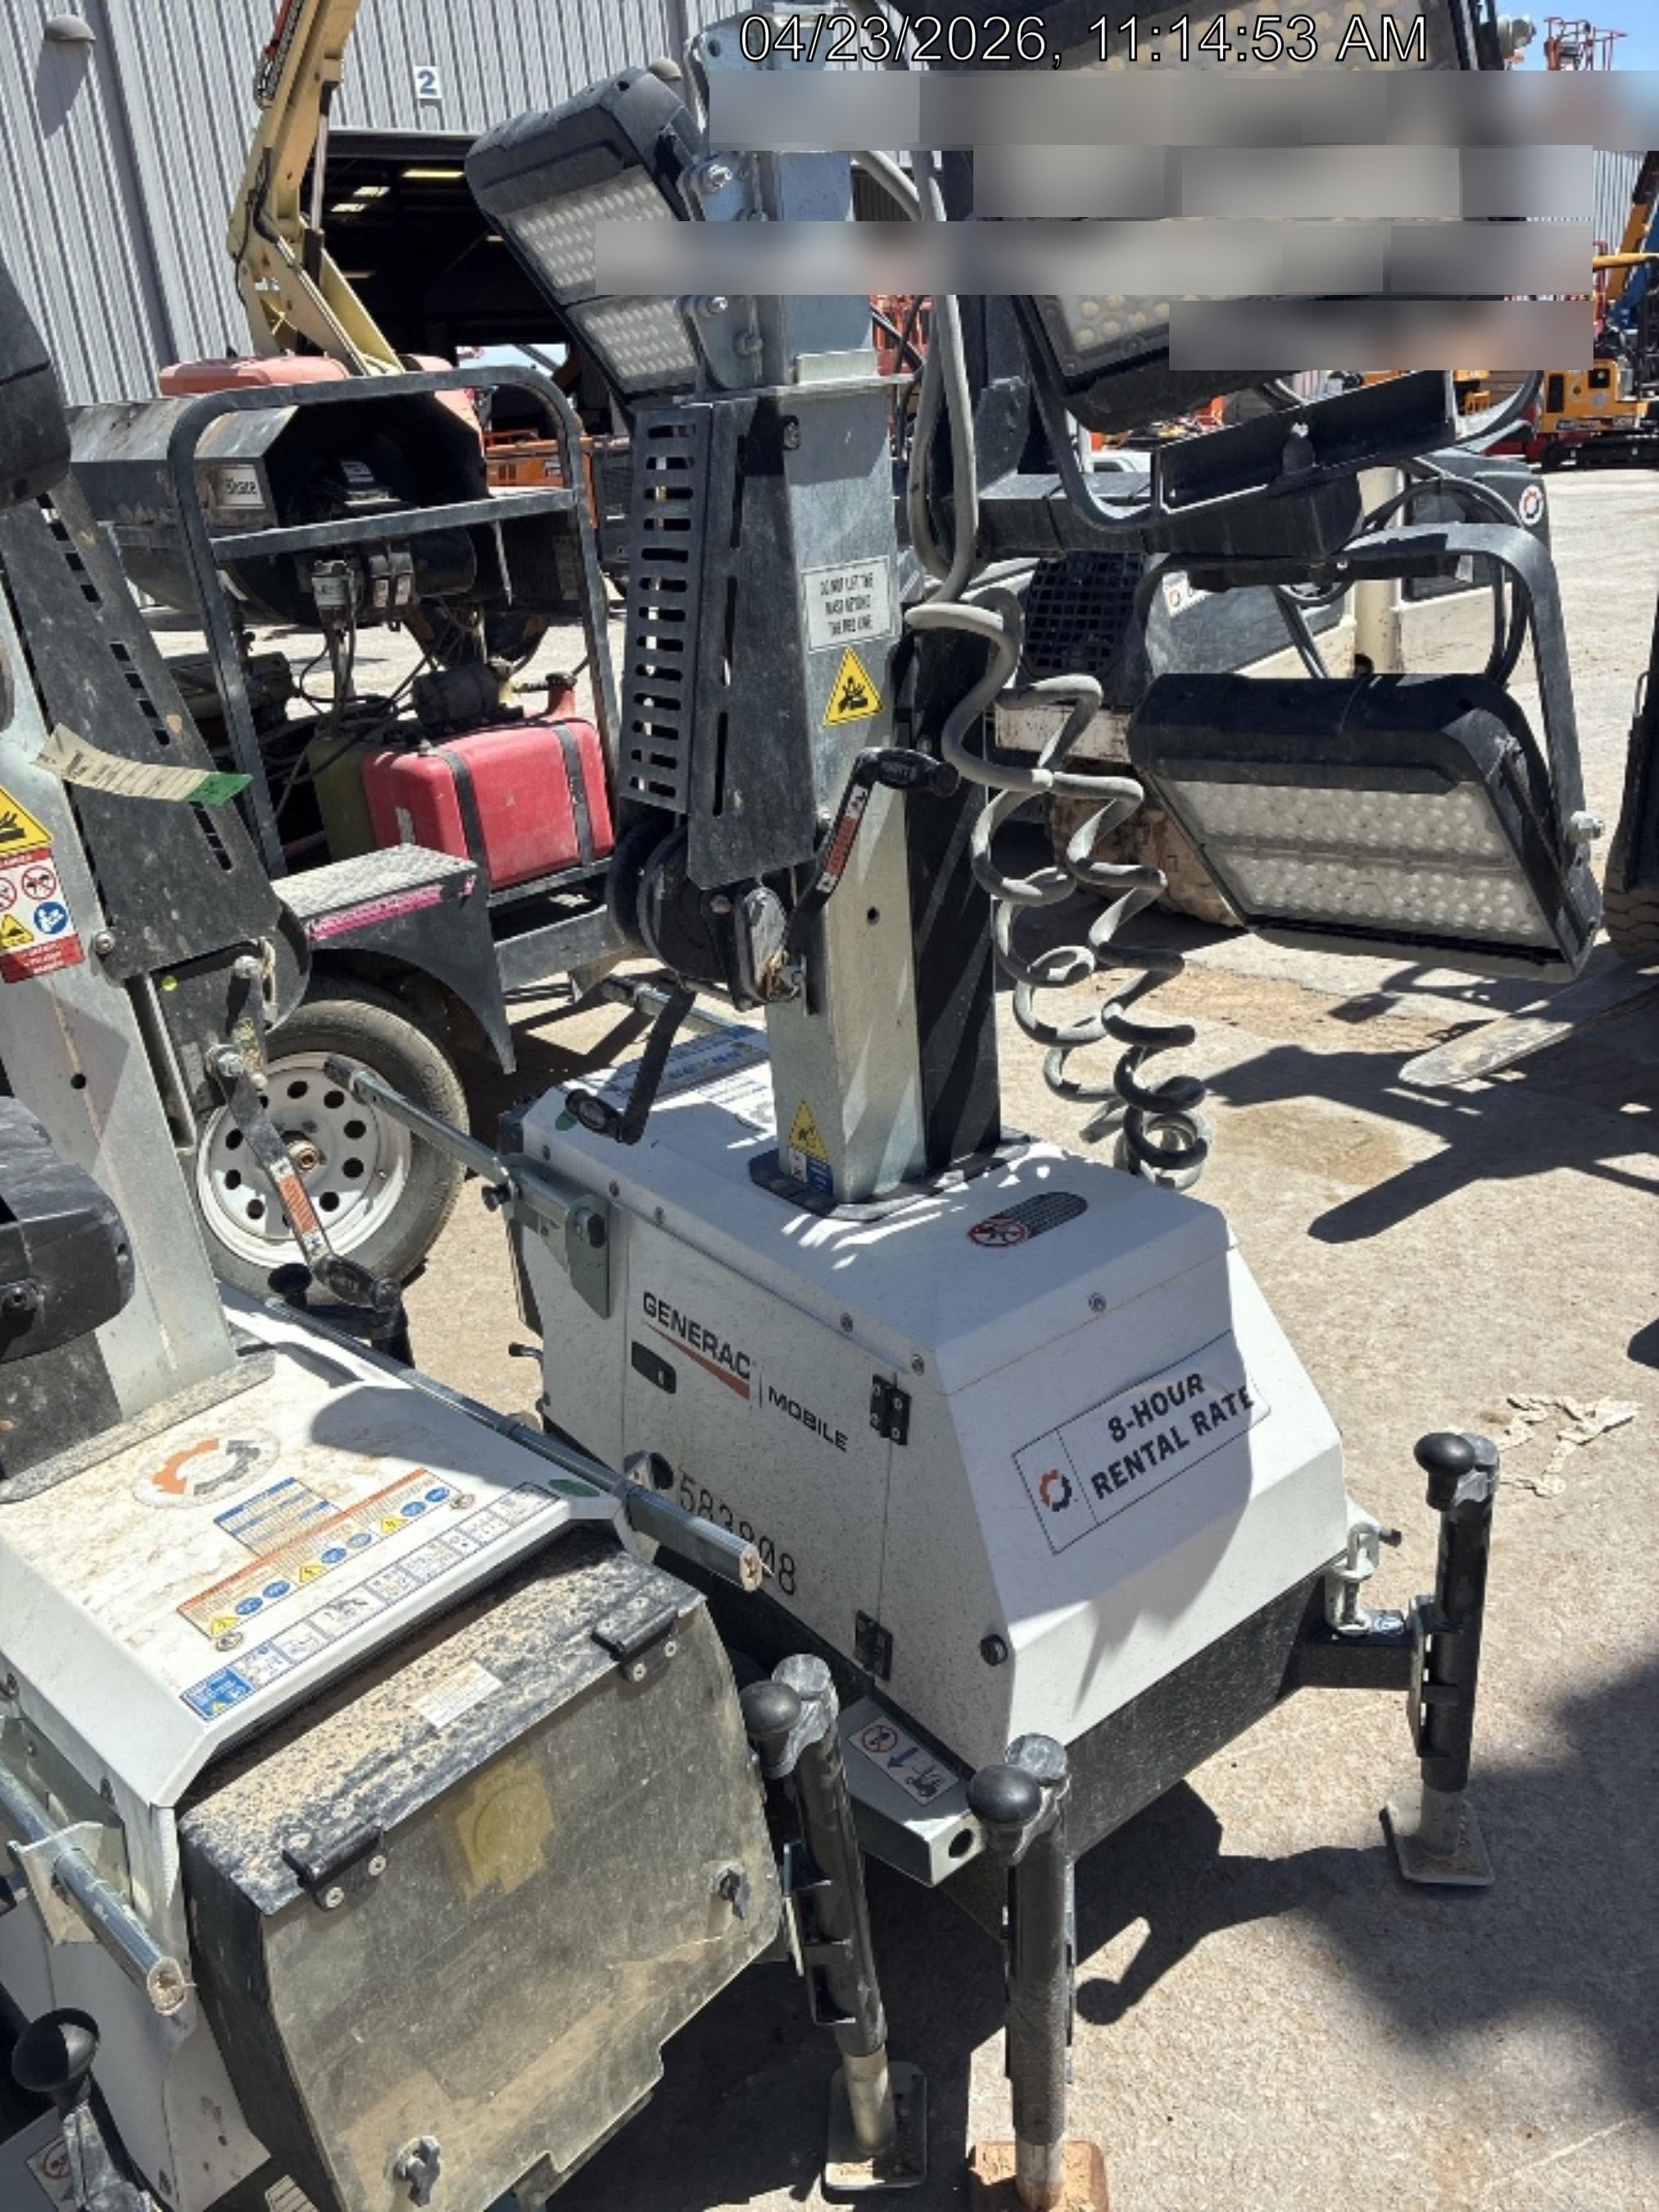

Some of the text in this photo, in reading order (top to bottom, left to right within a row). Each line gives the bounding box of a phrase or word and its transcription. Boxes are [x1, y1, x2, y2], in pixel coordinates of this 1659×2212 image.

[417, 70, 437, 95] 2
[643, 1291, 751, 1380] GENERAC
[768, 1385, 849, 1453] MOBILE
[1090, 1385, 1255, 1500] RENTAL RATE
[1108, 1373, 1205, 1443] 8-HOUR
